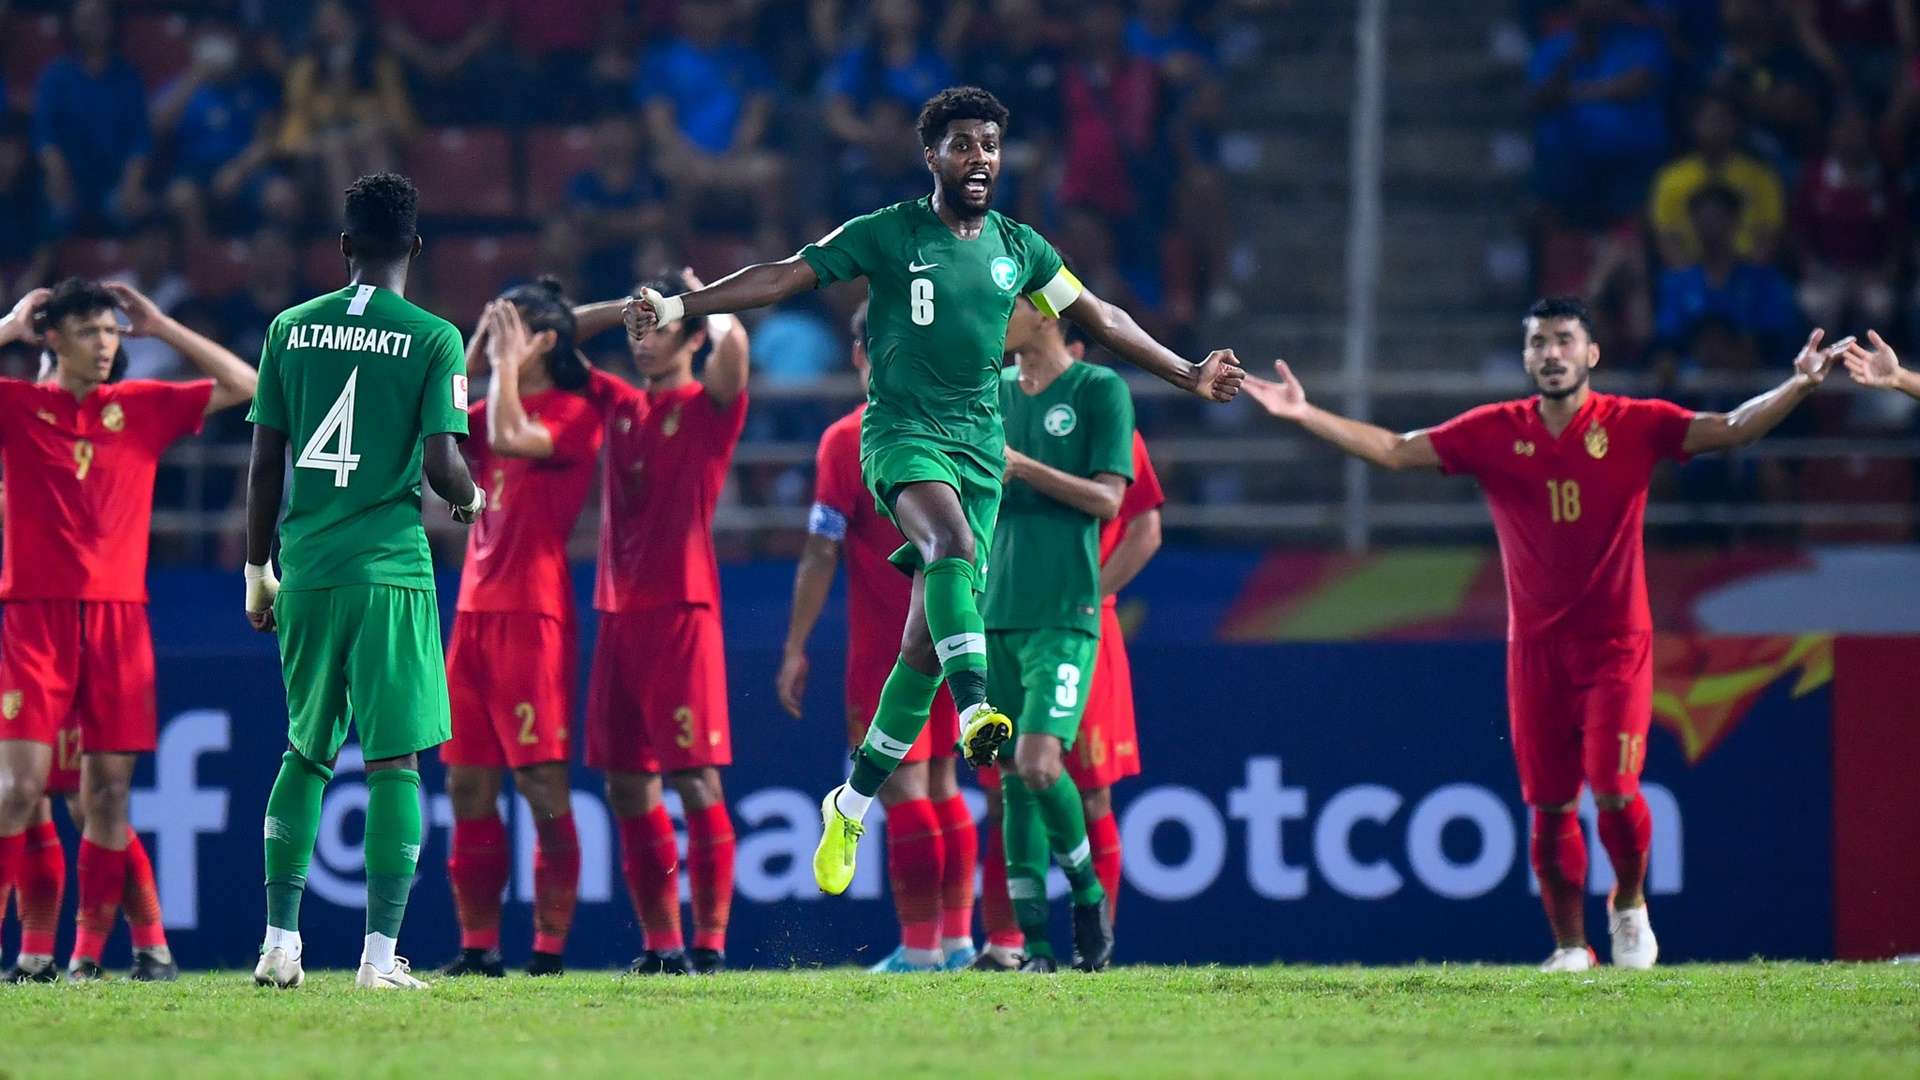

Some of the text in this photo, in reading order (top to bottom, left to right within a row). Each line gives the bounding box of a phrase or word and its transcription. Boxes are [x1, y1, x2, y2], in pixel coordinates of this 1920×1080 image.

[911, 278, 934, 326] 6
[287, 324, 412, 358] ALTAMBAKTI
[295, 365, 361, 488] 4
[73, 439, 93, 480] 9
[1546, 479, 1581, 523] 18
[1055, 663, 1080, 708] 3
[515, 702, 539, 745] 2
[673, 706, 694, 748] 3
